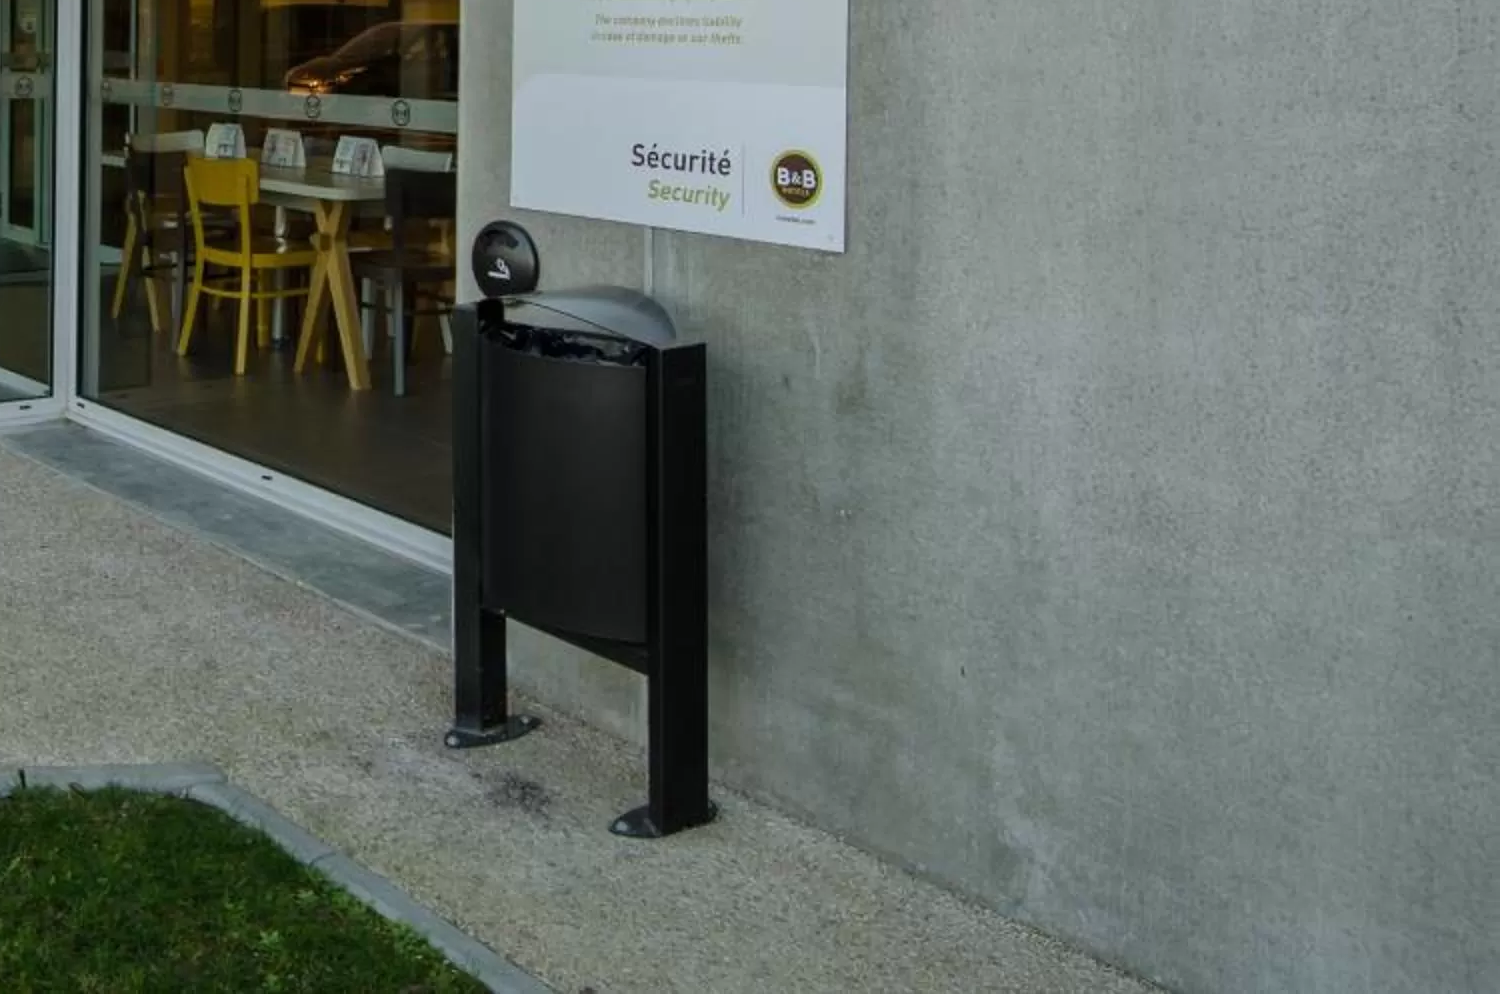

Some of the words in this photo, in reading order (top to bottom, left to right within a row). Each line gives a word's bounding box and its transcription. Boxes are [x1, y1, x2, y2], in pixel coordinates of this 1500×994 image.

[631, 143, 731, 175] Sécurité
[777, 166, 817, 189] B&B
[647, 178, 731, 212] Security
